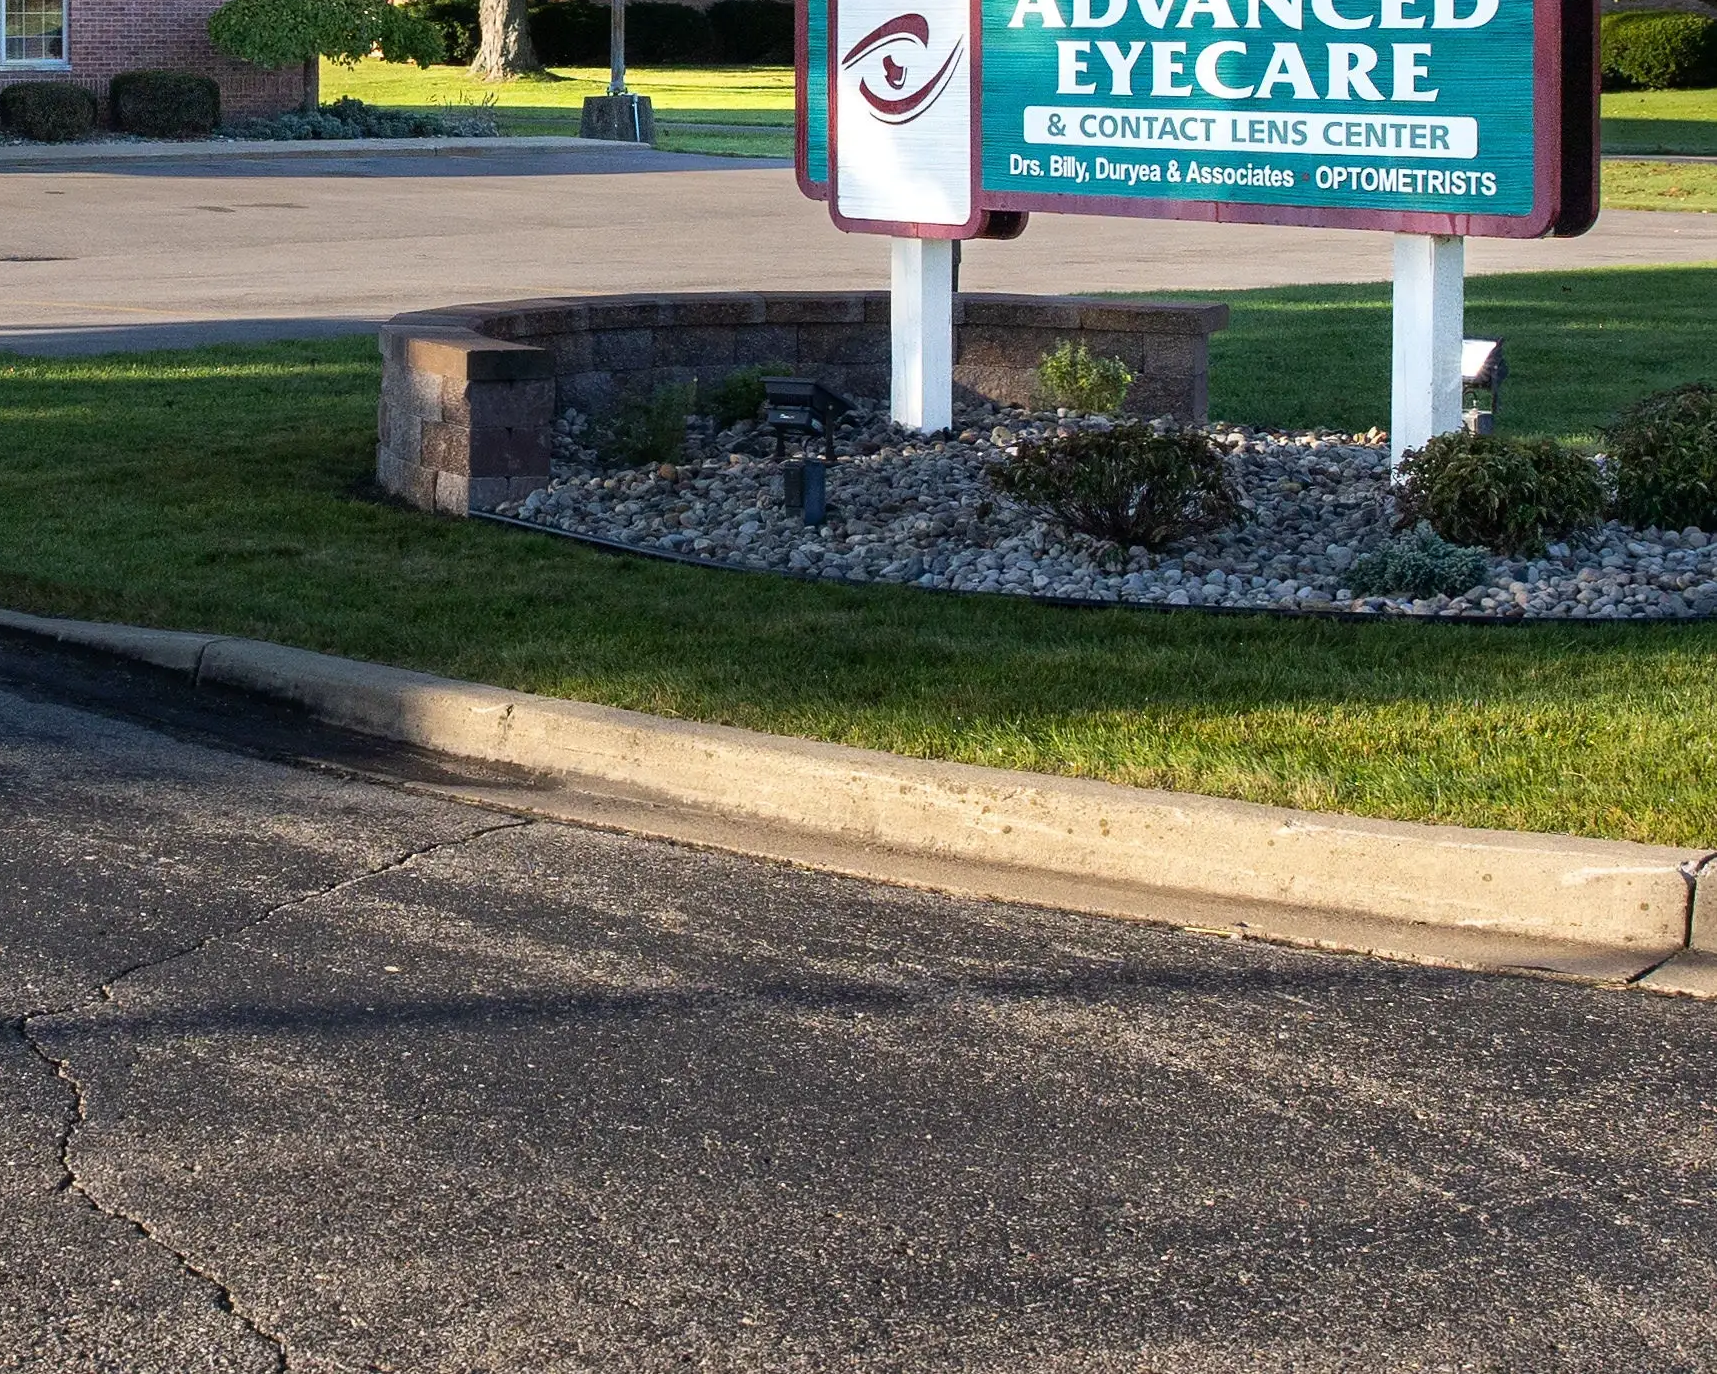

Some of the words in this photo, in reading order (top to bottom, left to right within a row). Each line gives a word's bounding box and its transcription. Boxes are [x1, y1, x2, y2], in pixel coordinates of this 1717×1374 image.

[1055, 40, 1440, 102] EYECARE
[1046, 113, 1067, 137] &
[1079, 114, 1216, 142] CONTACT
[1231, 119, 1308, 146] LENS
[1322, 121, 1450, 150] CENTER
[1009, 153, 1044, 177] Drs.
[1050, 155, 1090, 183] Billy,
[1095, 157, 1162, 186] Duryea
[1166, 159, 1181, 183] &
[1186, 160, 1295, 188] Associates
[1315, 165, 1498, 196] OPTOMETRISTS
